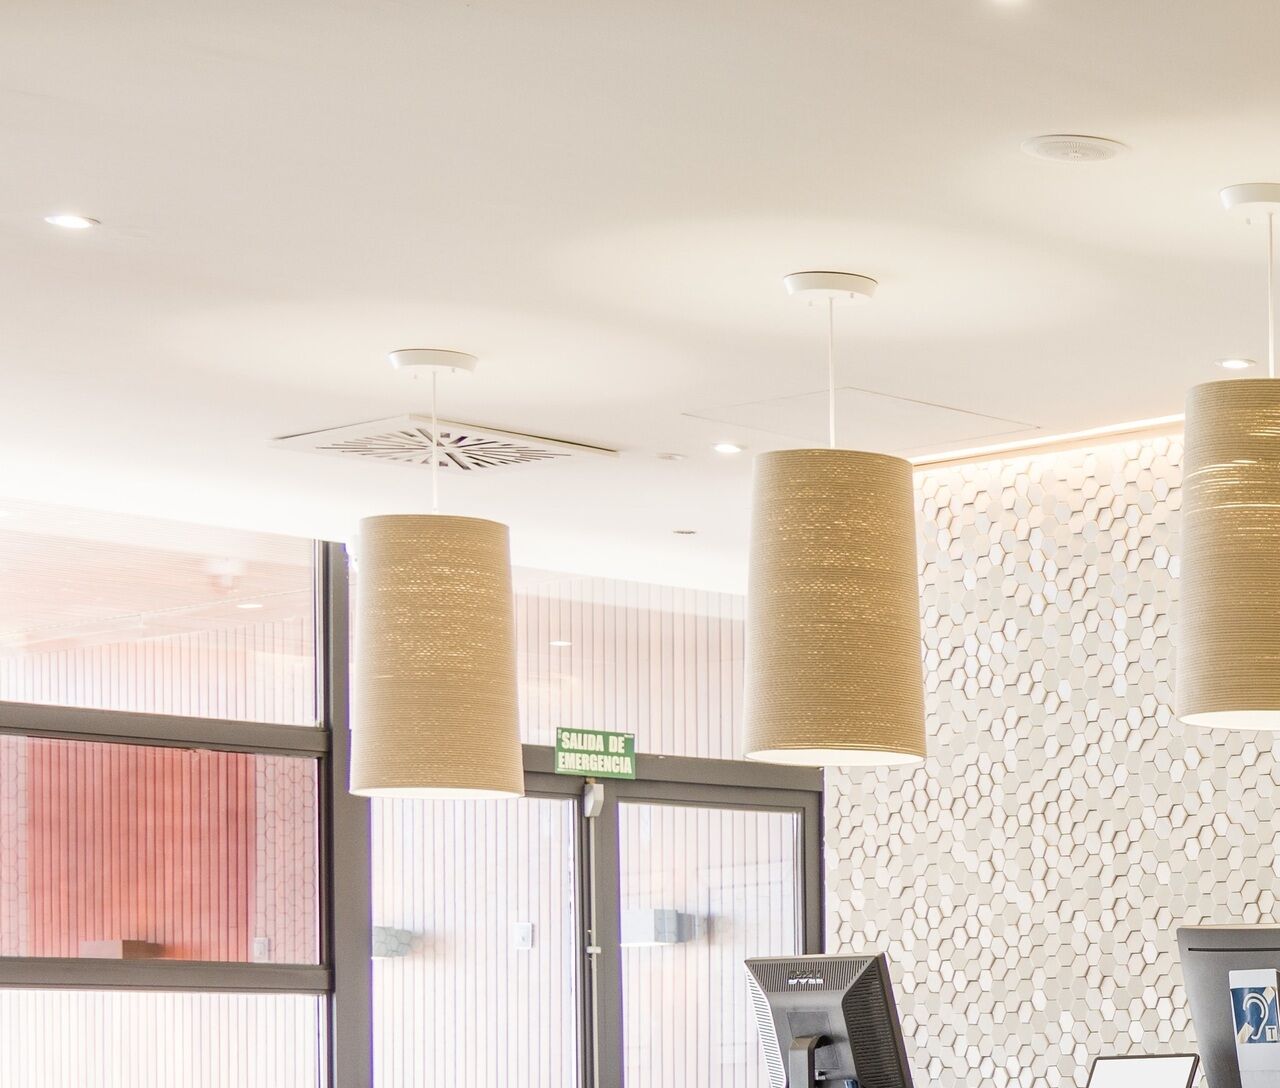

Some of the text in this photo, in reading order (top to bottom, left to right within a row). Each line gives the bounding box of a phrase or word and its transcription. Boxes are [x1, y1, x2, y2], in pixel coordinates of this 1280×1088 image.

[561, 732, 604, 751] SALIDA
[608, 735, 625, 753] DE
[558, 751, 632, 774] EMERGENCIA
[1267, 1027, 1275, 1040] T
